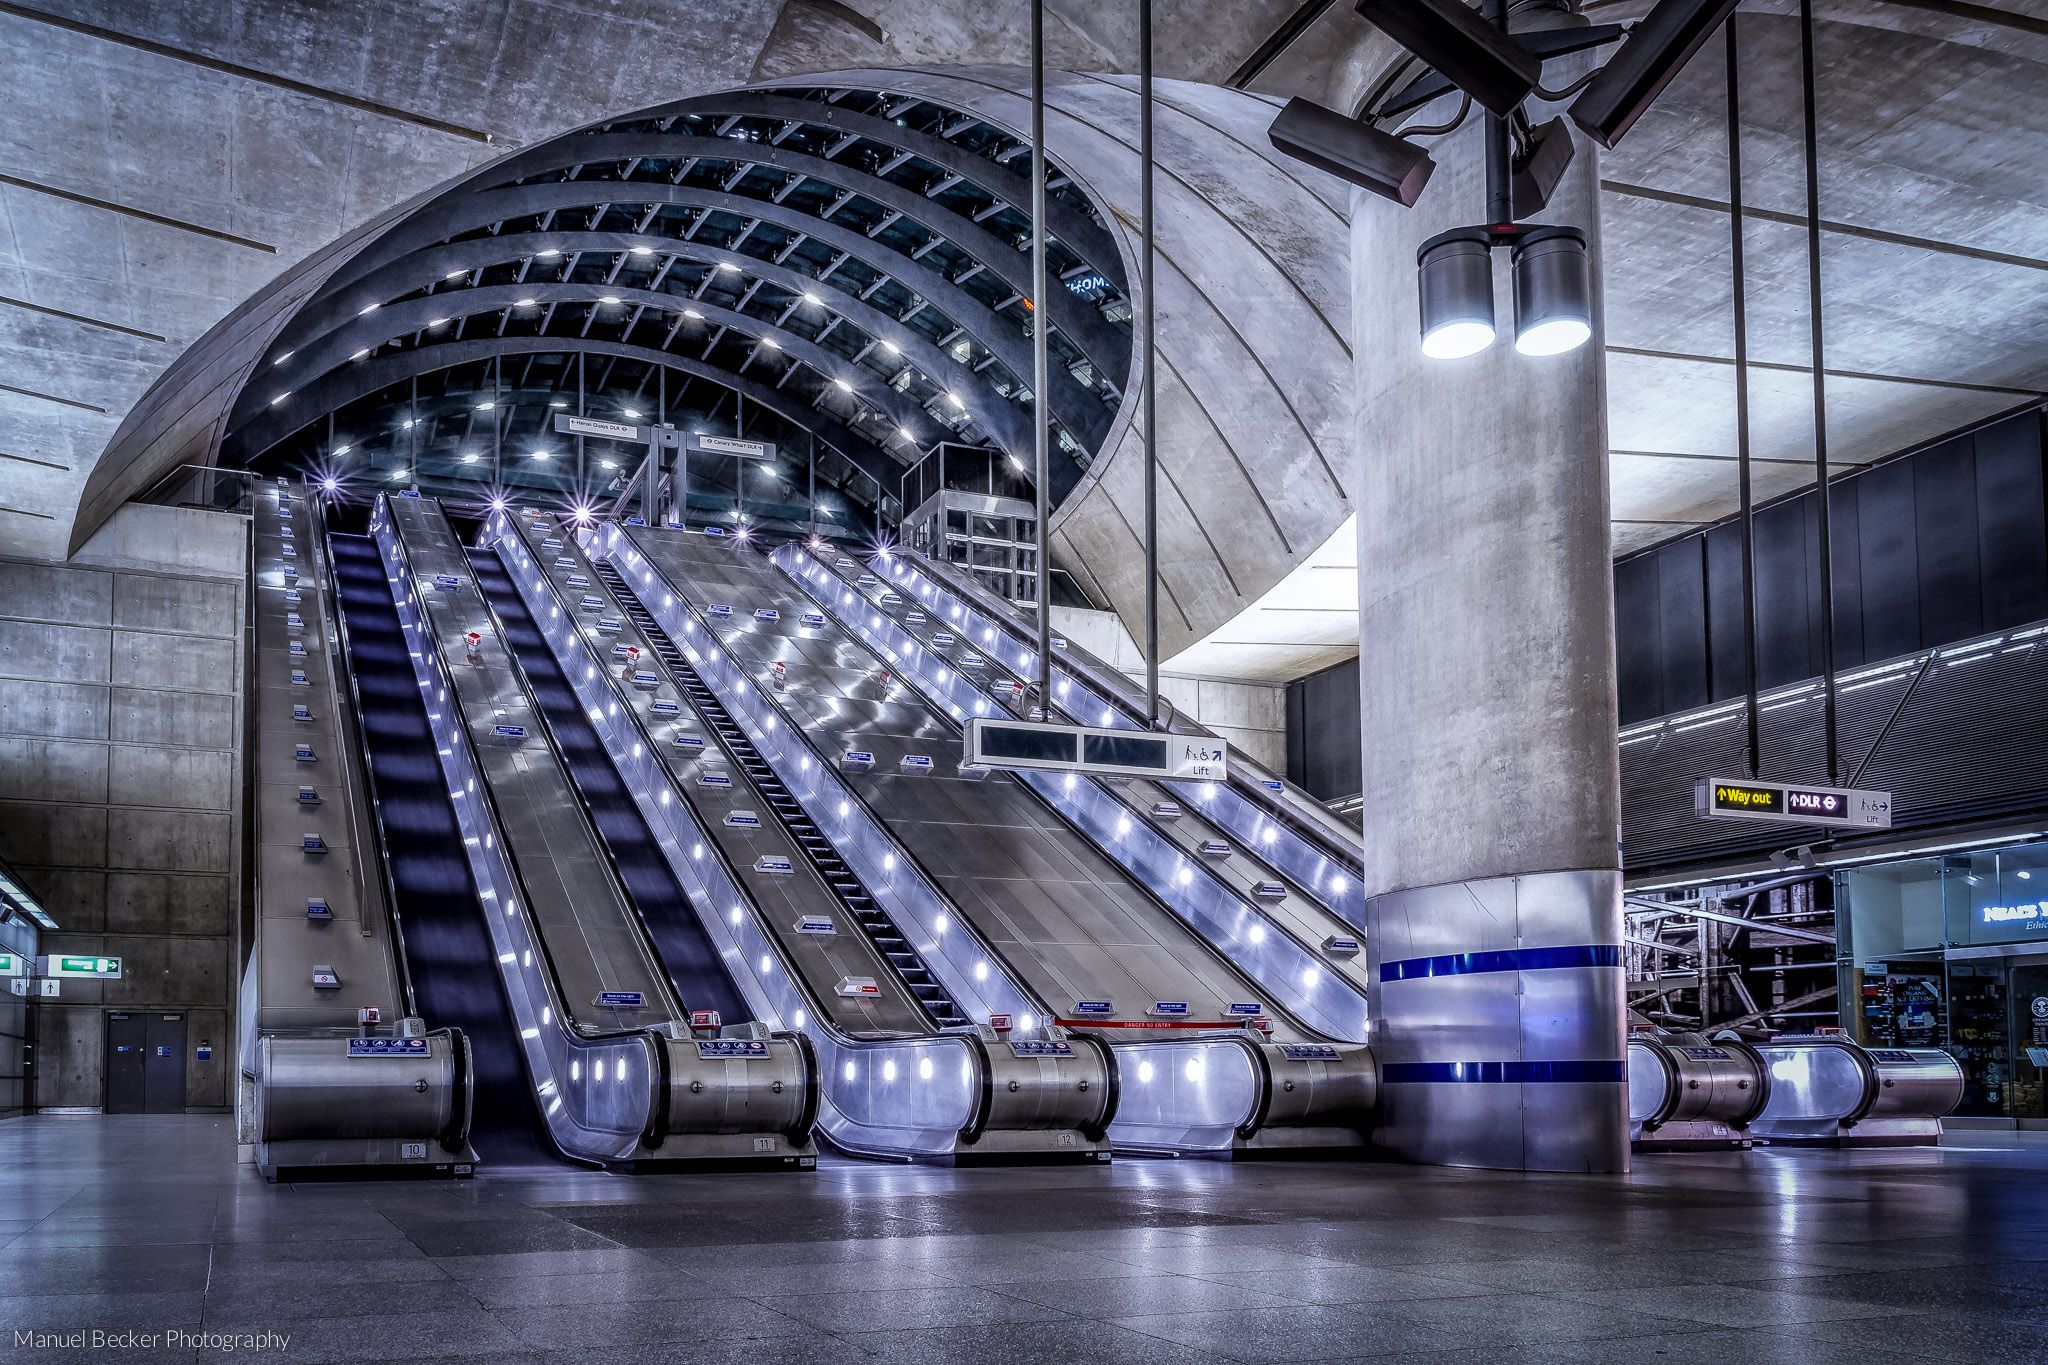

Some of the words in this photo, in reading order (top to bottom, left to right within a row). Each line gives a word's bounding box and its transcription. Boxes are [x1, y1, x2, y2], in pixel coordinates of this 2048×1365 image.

[714, 439, 730, 447] Canary
[1193, 765, 1210, 776] Lift
[1727, 788, 1750, 805] Way
[1752, 792, 1771, 804] out
[1800, 794, 1821, 808] DLR
[1866, 815, 1879, 824] Lift
[759, 1139, 769, 1150] 11
[1062, 1134, 1071, 1144] 12
[408, 1144, 420, 1155] 10
